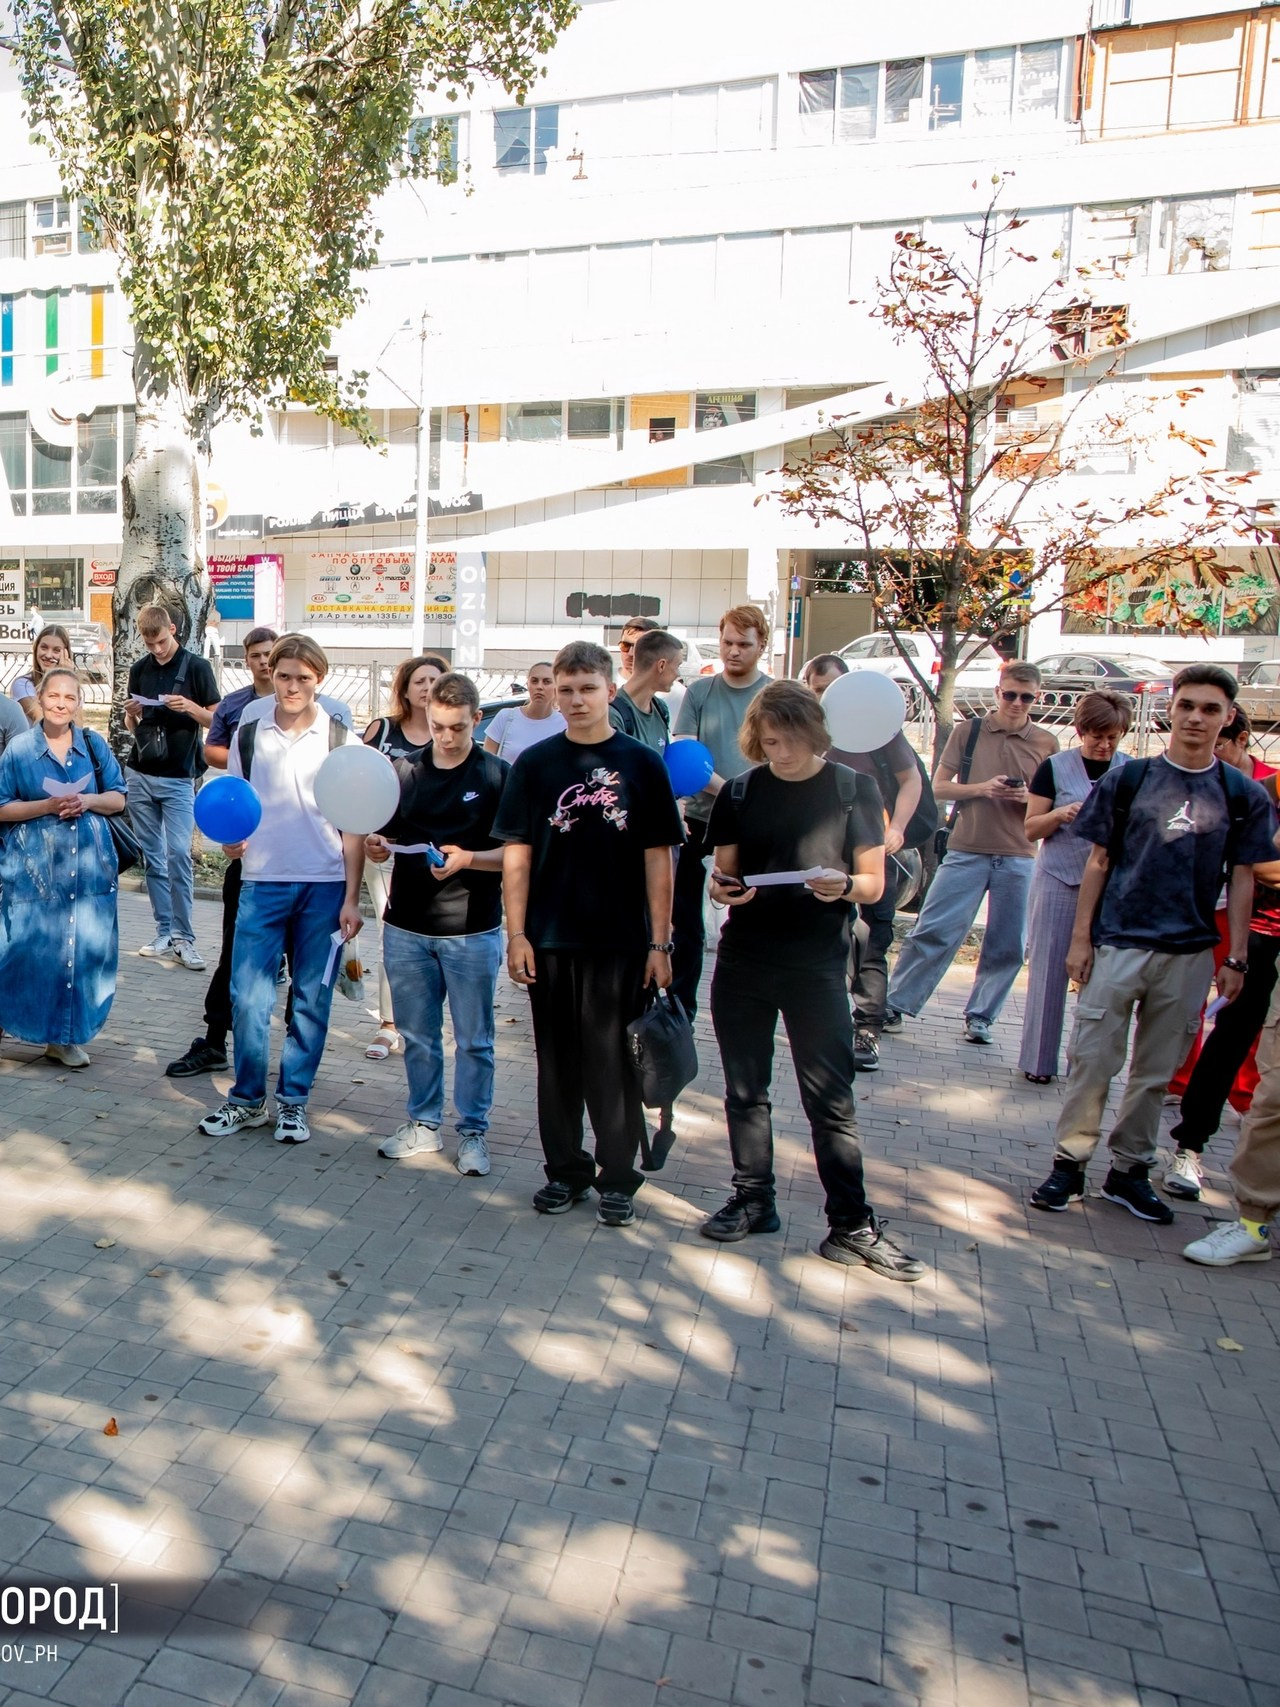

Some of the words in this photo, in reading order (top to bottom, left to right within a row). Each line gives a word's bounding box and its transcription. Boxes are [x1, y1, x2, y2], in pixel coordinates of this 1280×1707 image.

[439, 495, 471, 509] WOK
[321, 506, 365, 522] ПИЦЦА
[216, 563, 236, 572] ТВОЙ
[94, 573, 113, 582] ВХОД
[460, 566, 478, 662] OZON
